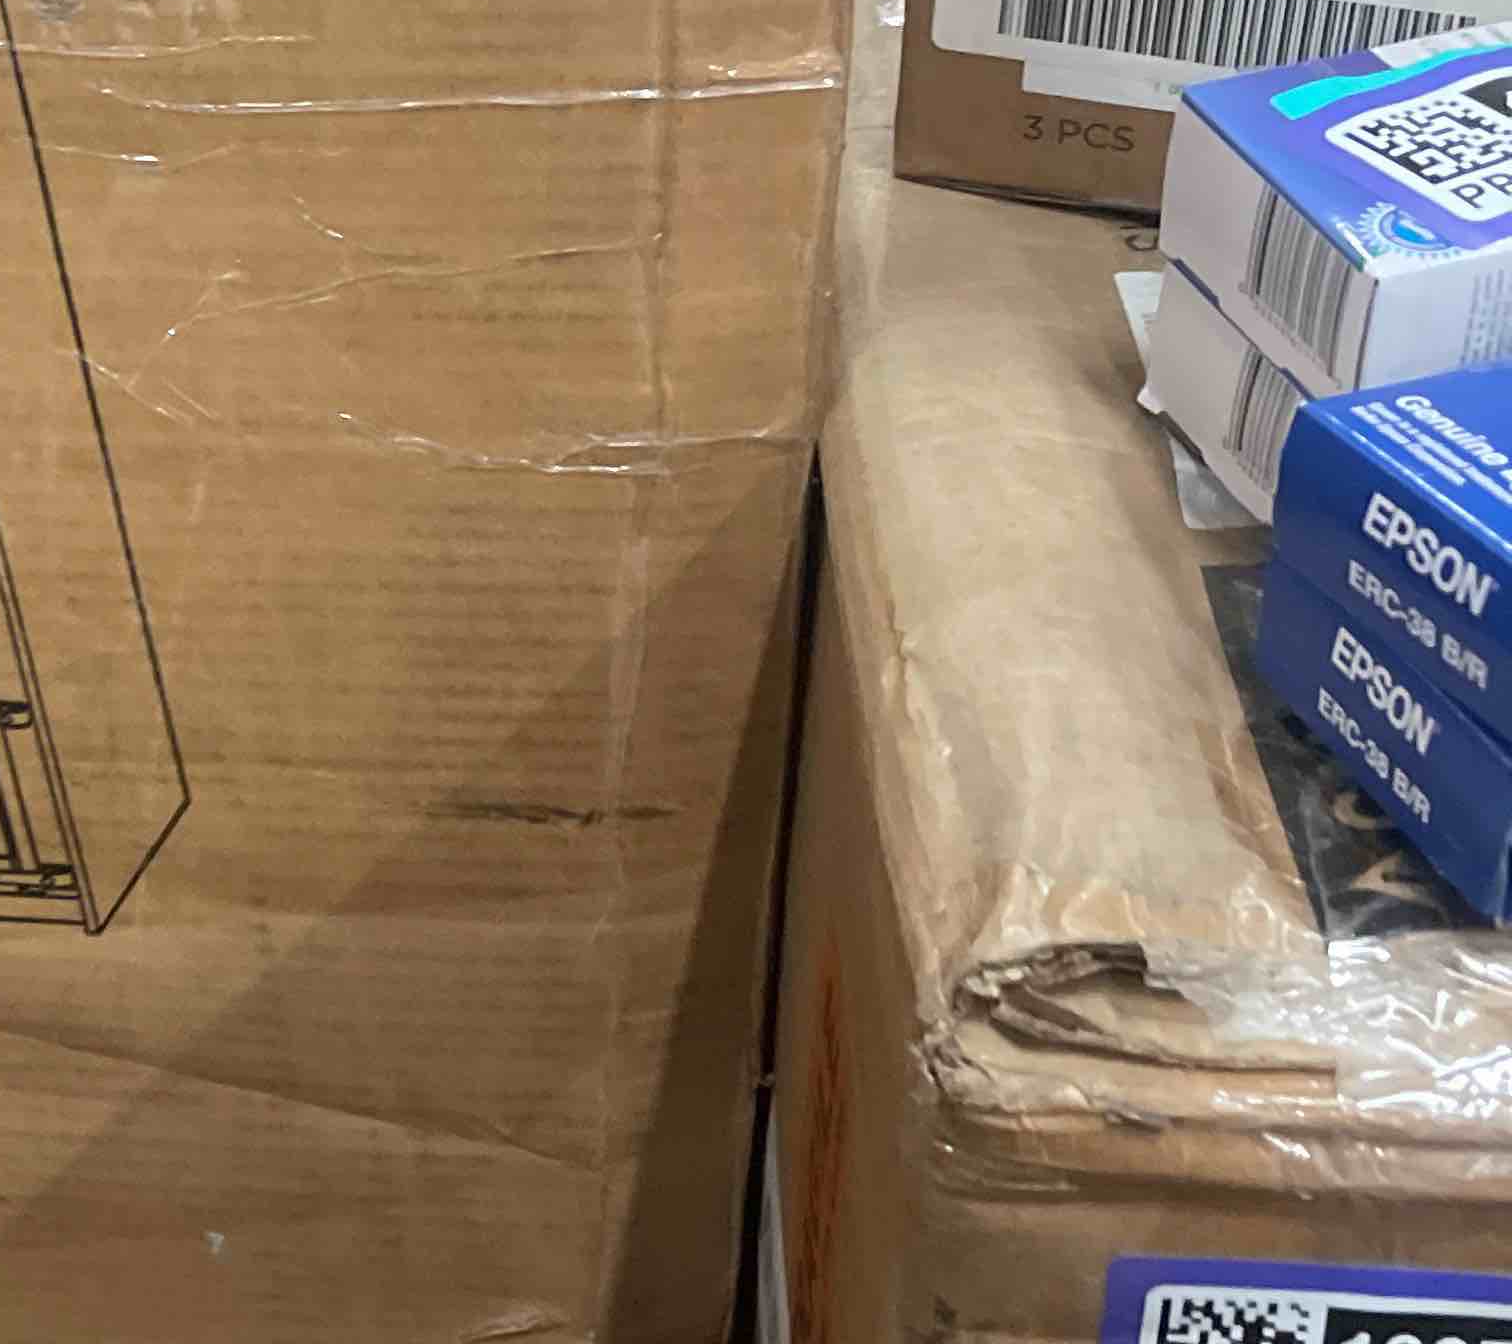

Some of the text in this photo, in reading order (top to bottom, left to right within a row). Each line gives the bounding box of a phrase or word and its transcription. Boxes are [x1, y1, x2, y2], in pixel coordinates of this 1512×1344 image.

[1022, 114, 1137, 153] 3 PCS
[1395, 395, 1509, 467] Genuine
[1362, 492, 1492, 617] EPSON
[1348, 559, 1487, 689] ERC-38 B/R
[1332, 627, 1435, 755] EPSON
[1318, 686, 1431, 824] ERC-38 B/R
